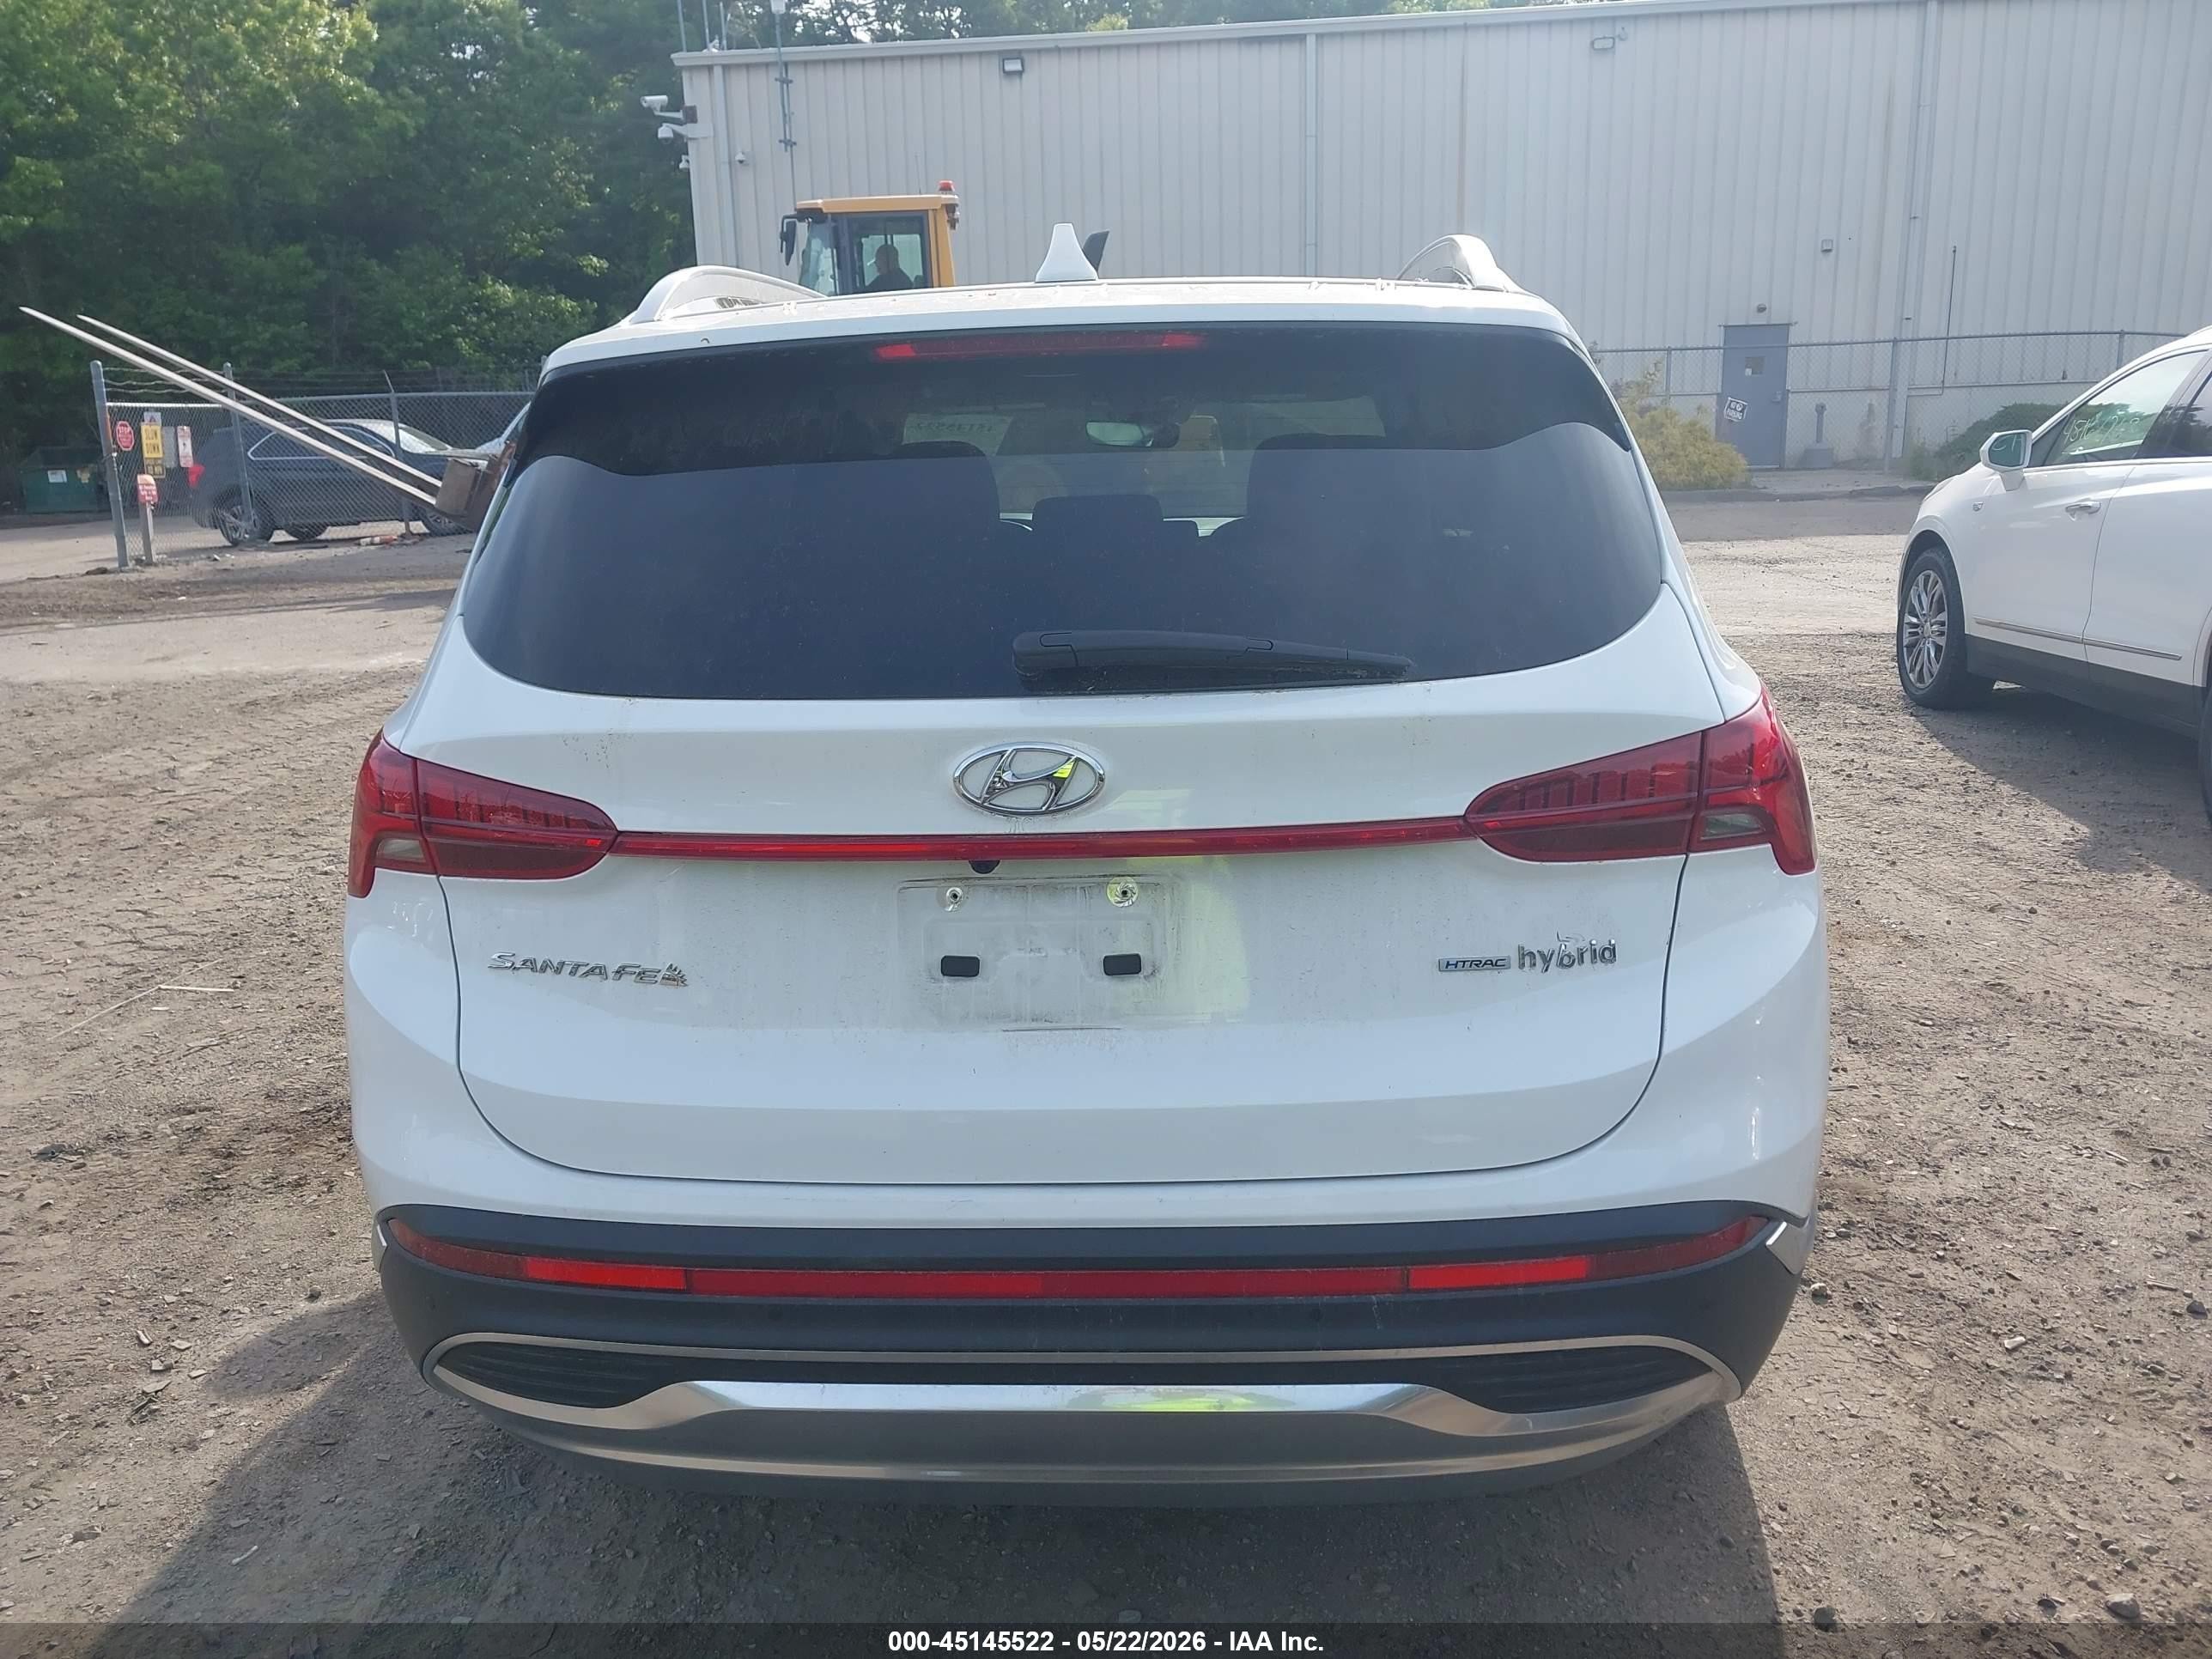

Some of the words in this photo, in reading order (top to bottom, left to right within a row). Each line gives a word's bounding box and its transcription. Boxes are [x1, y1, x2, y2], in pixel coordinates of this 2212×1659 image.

[144, 428, 159, 441] SLOW
[145, 442, 161, 454] DOWN
[1444, 957, 1507, 969] HTRAC
[1517, 938, 1618, 974] hybrid
[488, 951, 609, 981] SANTA
[611, 963, 662, 985] FE
